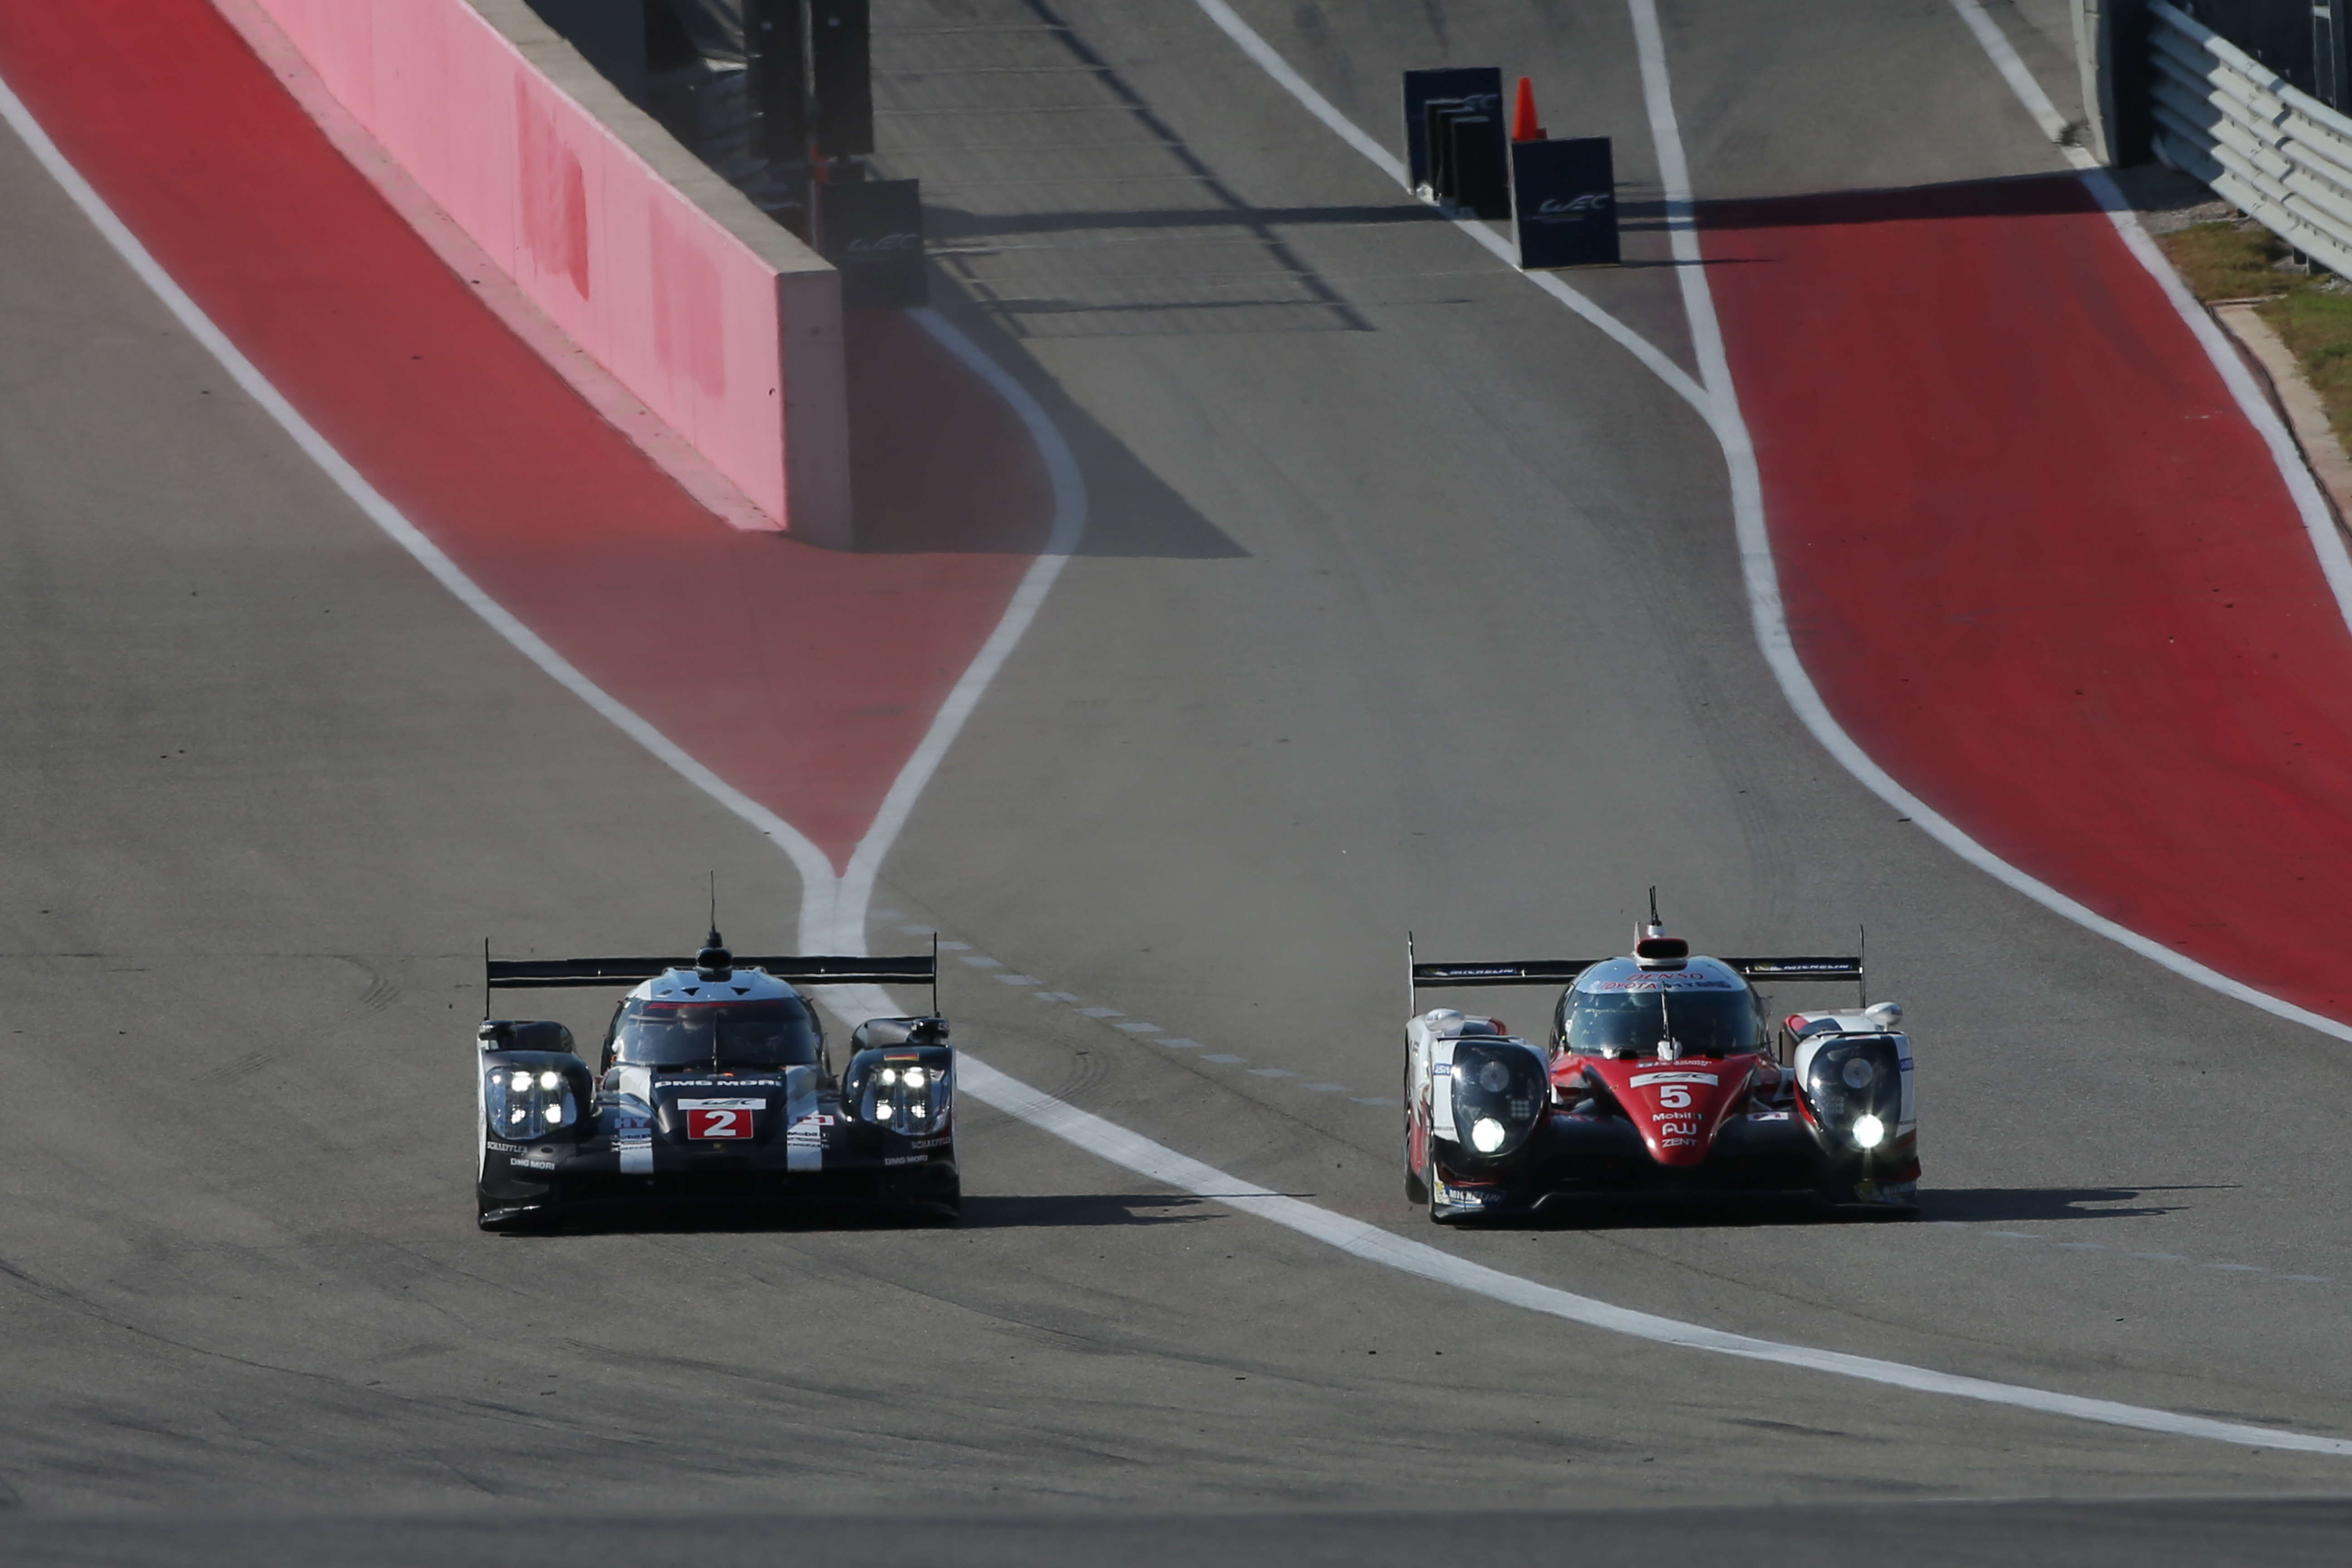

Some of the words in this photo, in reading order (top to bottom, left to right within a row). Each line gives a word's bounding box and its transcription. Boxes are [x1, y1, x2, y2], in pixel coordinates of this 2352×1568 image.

[1538, 193, 1610, 213] WEC
[1600, 981, 1657, 989] TOYOTA
[654, 1080, 713, 1088] DMG
[1661, 1085, 1691, 1108] 5
[704, 1110, 737, 1136] 2
[1652, 1112, 1691, 1122] Mobil
[1662, 1138, 1698, 1148] ZENT
[510, 1158, 529, 1166] DMG
[530, 1161, 555, 1171] MORI
[885, 1157, 906, 1166] DMG
[906, 1155, 928, 1163] MORI
[1449, 1189, 1500, 1202] MICHELIN
